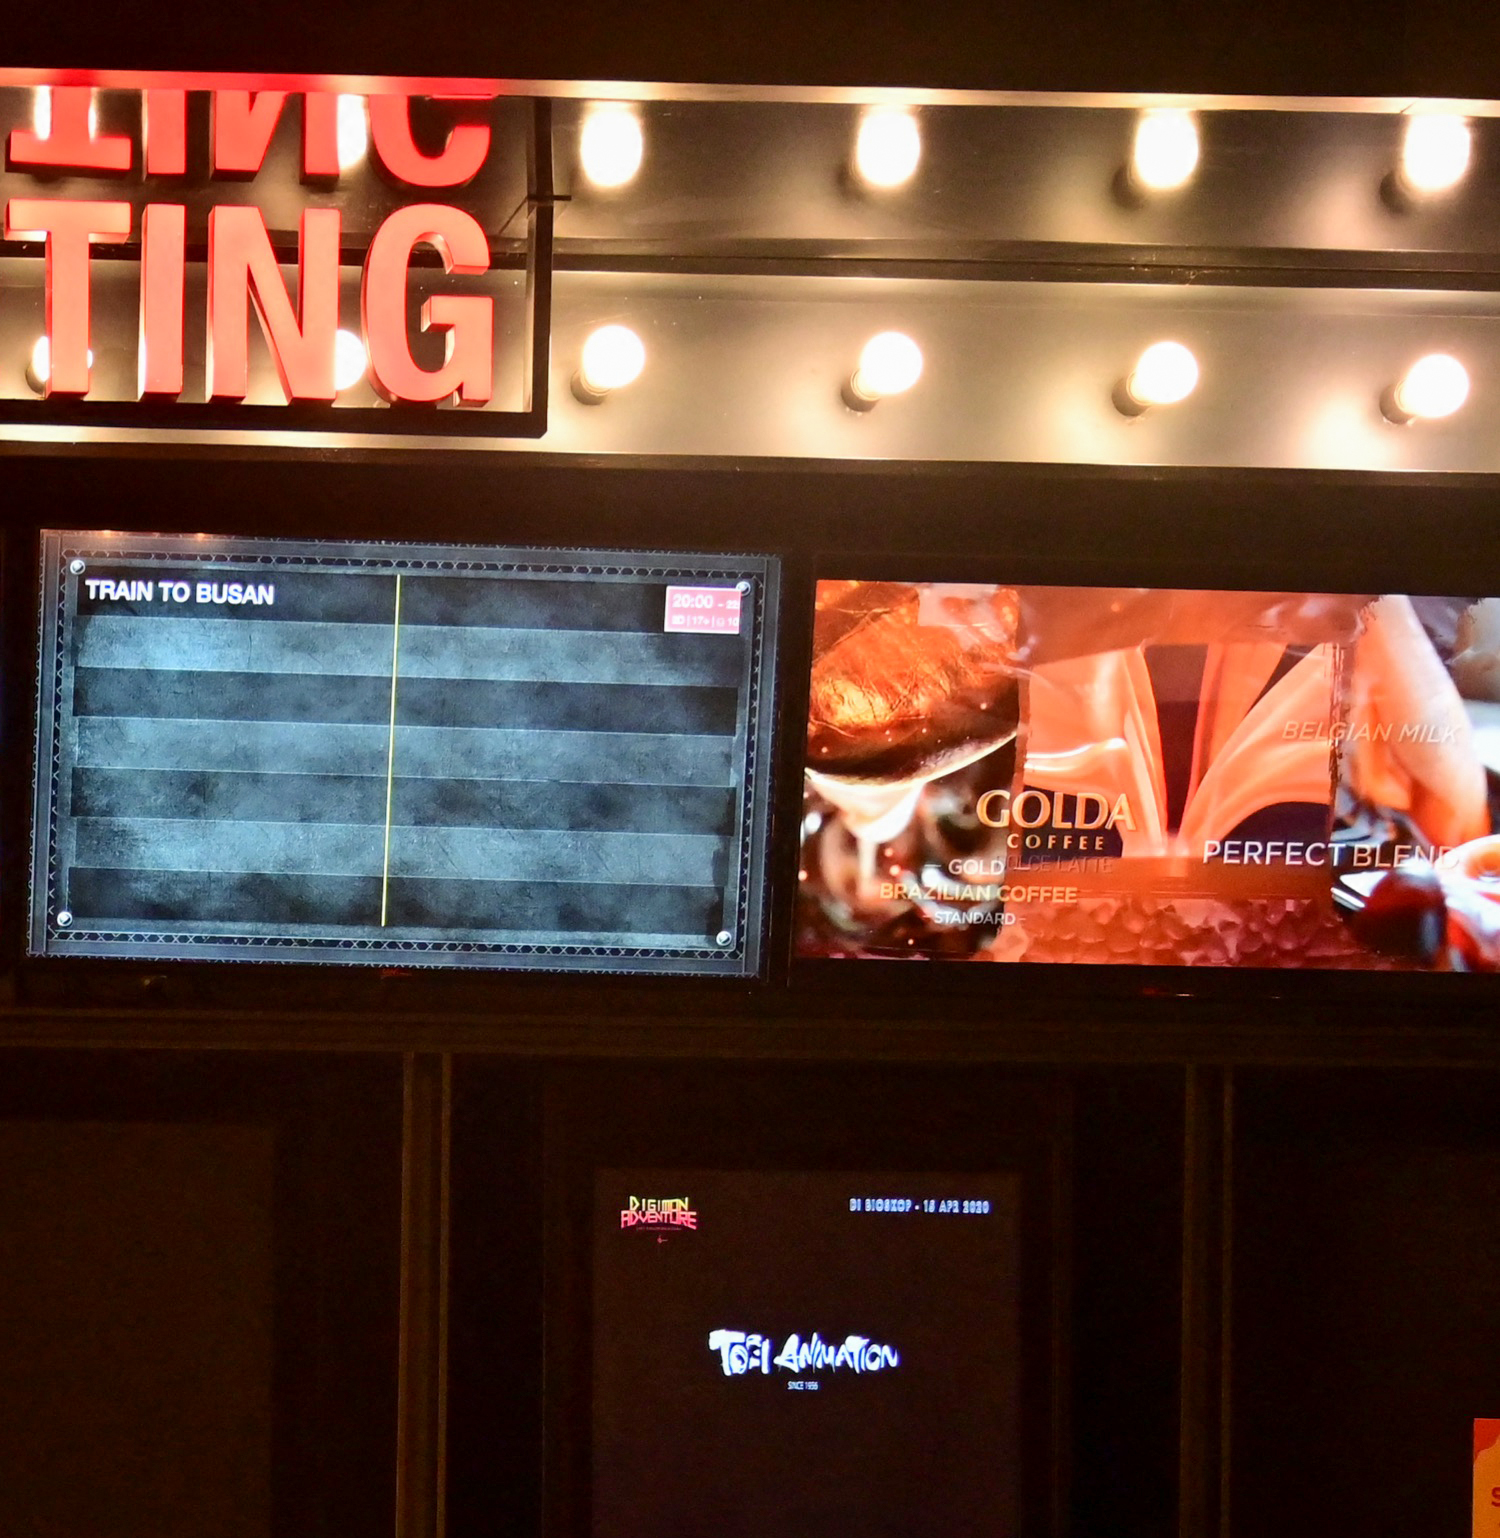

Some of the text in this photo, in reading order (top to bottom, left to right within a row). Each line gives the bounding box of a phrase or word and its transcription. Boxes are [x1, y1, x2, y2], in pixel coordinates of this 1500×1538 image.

[84, 578, 275, 606] TRAIN TO BUSAN
[672, 593, 713, 608] 20:00
[1281, 719, 1463, 745] BELGIAN MILK
[975, 788, 1137, 832] GOLDA
[1006, 832, 1105, 851] COFFEE
[947, 857, 1005, 876] GOLD
[1201, 840, 1460, 872] PERFECT BLEND
[879, 882, 1079, 904] BRAZILIAN COFFEE
[933, 910, 1017, 927] STANDARD
[629, 1195, 689, 1212] DIGIMON
[938, 1199, 960, 1213] APR
[962, 1200, 990, 1213] 2020
[620, 1210, 697, 1231] ADVENTURE
[773, 1332, 898, 1374] ANIMATION
